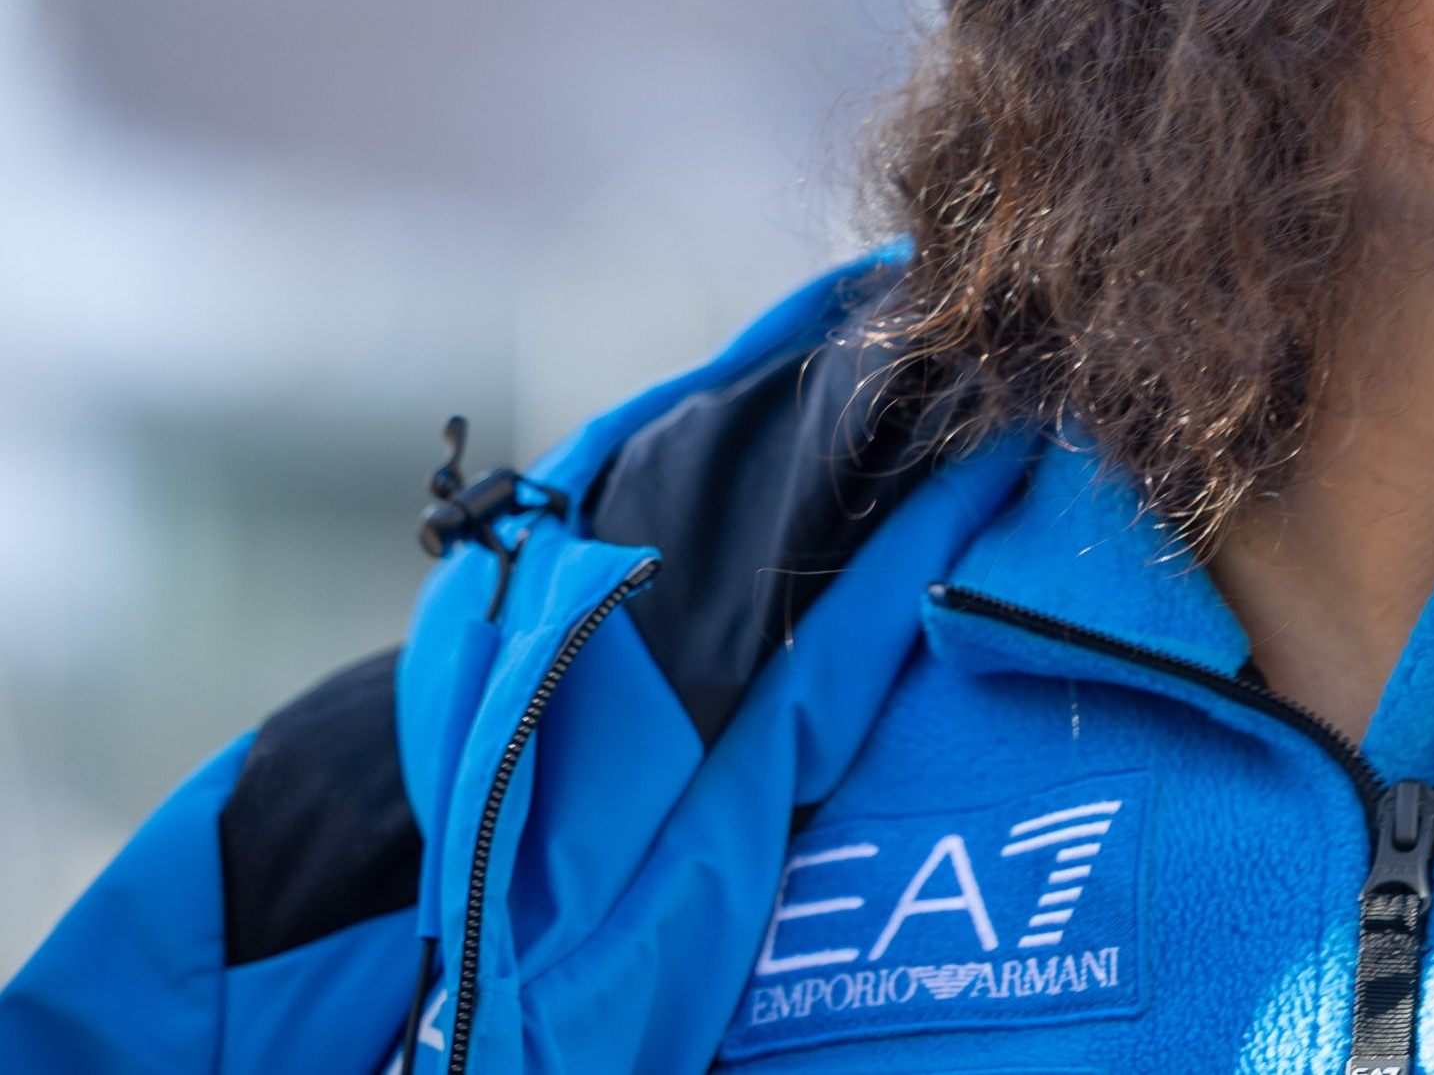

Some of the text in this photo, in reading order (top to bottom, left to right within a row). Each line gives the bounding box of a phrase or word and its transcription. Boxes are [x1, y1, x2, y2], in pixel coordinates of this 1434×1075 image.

[755, 800, 1123, 976] EA7
[751, 947, 1121, 1025] EMPORIO ARMANI
